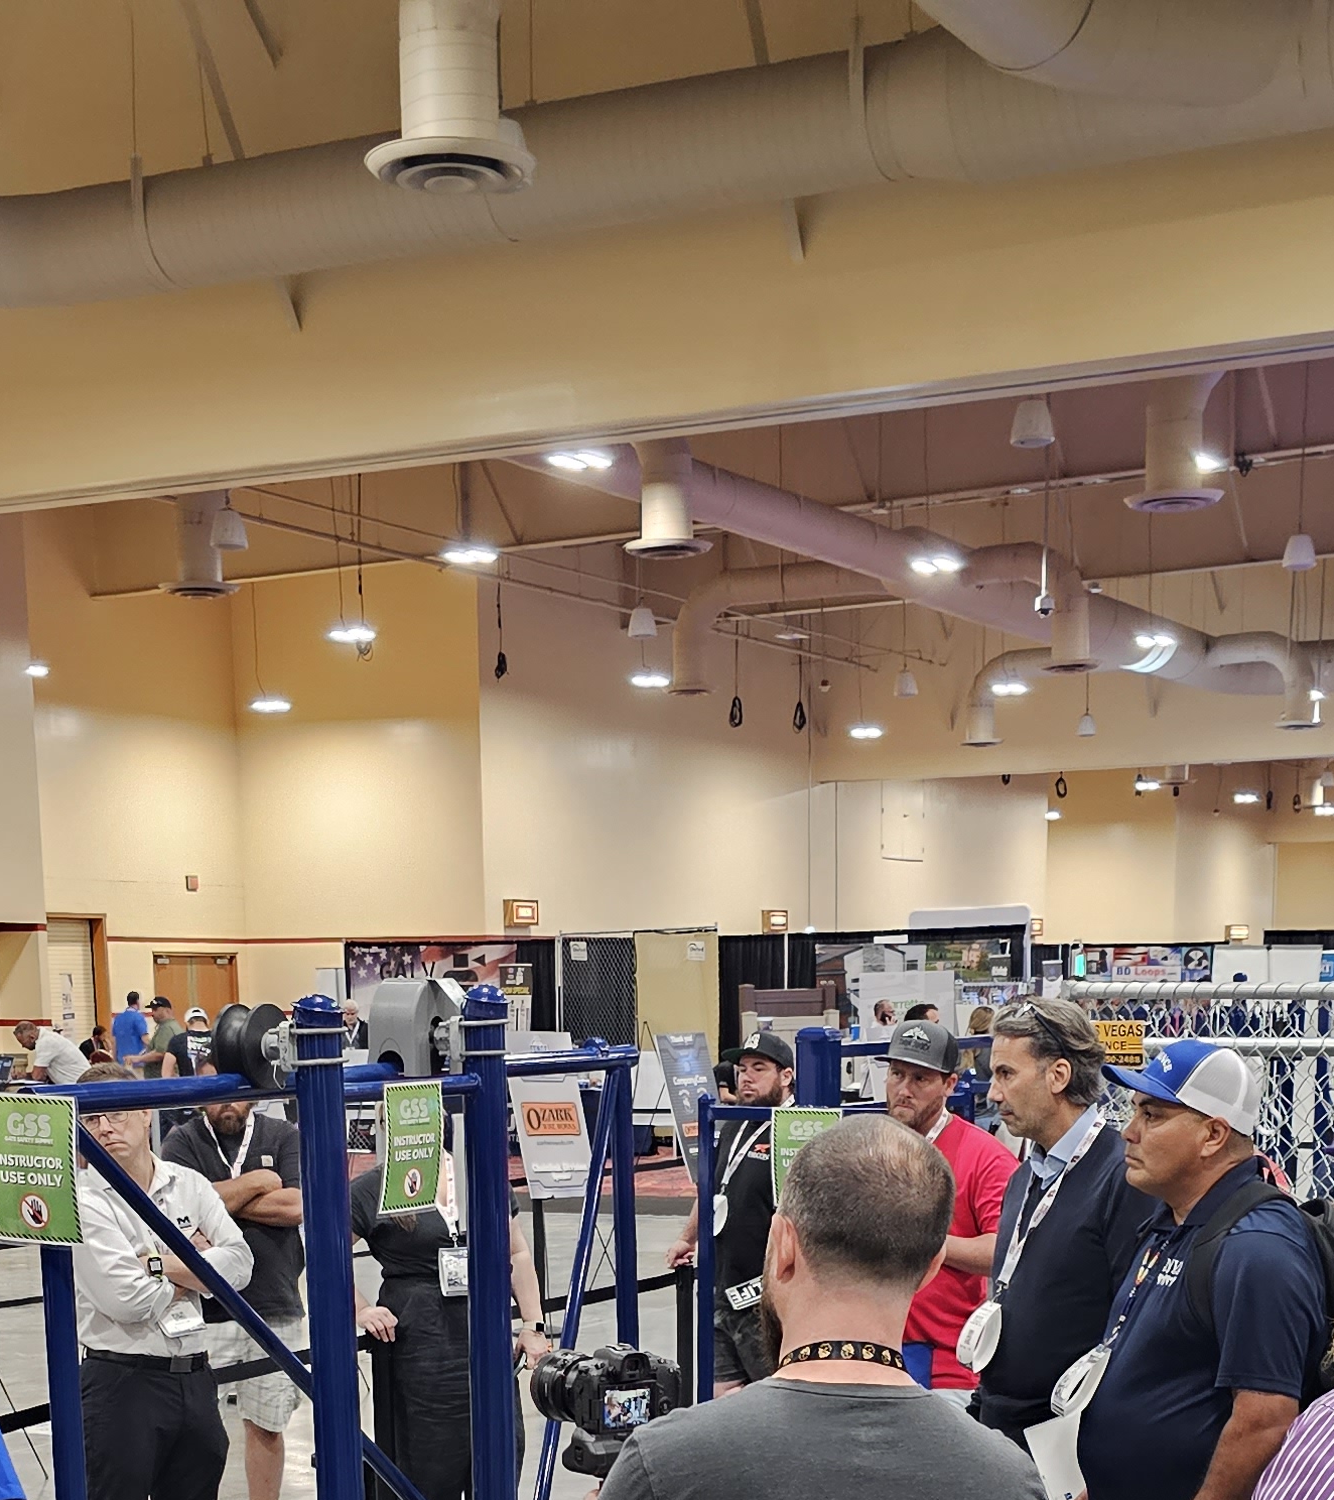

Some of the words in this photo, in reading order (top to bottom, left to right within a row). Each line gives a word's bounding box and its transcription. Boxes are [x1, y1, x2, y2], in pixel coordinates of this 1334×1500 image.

[1117, 966, 1131, 976] BD
[1134, 966, 1166, 977] Loops
[1103, 1024, 1143, 1038] VEGAS
[399, 1098, 428, 1119] GSS
[7, 1112, 51, 1138] GSS
[526, 1107, 574, 1131] OZARK
[393, 1133, 435, 1147] INSTRUCTOR
[395, 1150, 412, 1162] USE
[412, 1147, 434, 1160] ONLY
[0, 1170, 26, 1184] USE
[27, 1172, 63, 1187] ONLY
